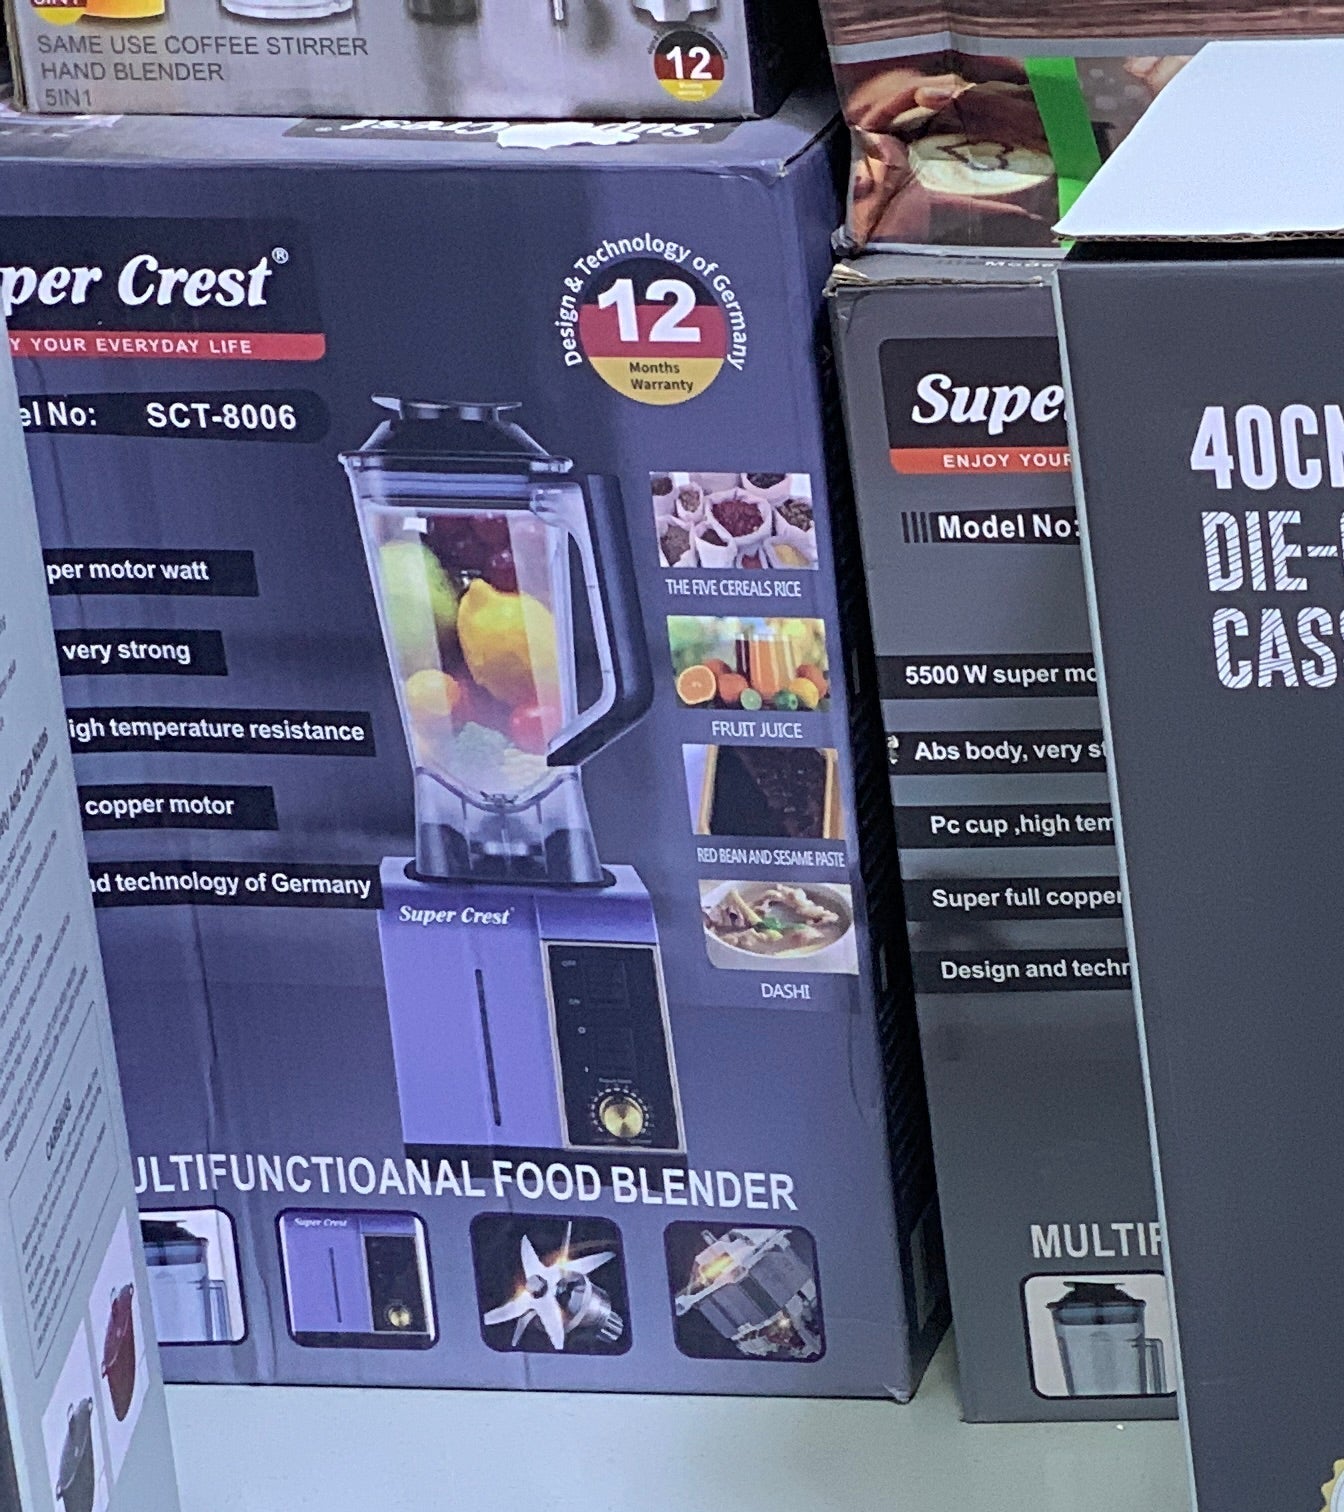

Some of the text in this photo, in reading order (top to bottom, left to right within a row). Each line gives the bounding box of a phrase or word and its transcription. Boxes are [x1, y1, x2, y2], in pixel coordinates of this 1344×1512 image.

[37, 35, 368, 56] SAME USE COFFEE STIRRER
[41, 62, 224, 80] HAND BLENDER
[666, 45, 712, 79] 12
[45, 89, 92, 106] 5IN1
[118, 254, 272, 306] Crest
[555, 232, 747, 371] Design & Technology of Germany
[597, 278, 701, 342] 12
[30, 338, 87, 352] YOUR
[96, 338, 199, 353] EVERYDAY
[209, 339, 252, 353] LIFE
[629, 362, 680, 373] Months
[631, 379, 693, 392] Warranty
[50, 401, 96, 426] No:
[147, 403, 296, 430] SCT-8006
[911, 373, 1070, 436] Supe
[943, 453, 1009, 468] ENJOY
[938, 513, 1025, 540] Model
[47, 561, 209, 584] per motor watt
[665, 579, 802, 597] THE FIVE CEREALS RICE
[63, 640, 190, 664] very strong
[905, 666, 959, 686] 5500
[962, 665, 987, 684] W
[993, 666, 1058, 688] super
[109, 719, 244, 740] temperature
[250, 720, 365, 742] resistance
[712, 721, 803, 739] FRUIT JUICE
[914, 741, 960, 761] Abs
[965, 741, 1028, 763] body,
[1032, 742, 1083, 762] very
[85, 797, 235, 818] copper motor
[931, 815, 961, 834] Pc
[965, 817, 1008, 838] cup
[697, 847, 846, 868] RED BEAN AND SESAME PASTE
[115, 871, 238, 895] technology
[245, 873, 267, 891] of
[271, 873, 371, 898] Germany
[932, 888, 1000, 911] Super
[1004, 887, 1040, 906] full
[399, 905, 510, 926] Super Crest
[940, 959, 1020, 982] Design
[1025, 959, 1067, 978] and
[761, 983, 811, 1000] DASHI
[493, 1160, 600, 1202] FOOD
[611, 1168, 798, 1210] BLENDER
